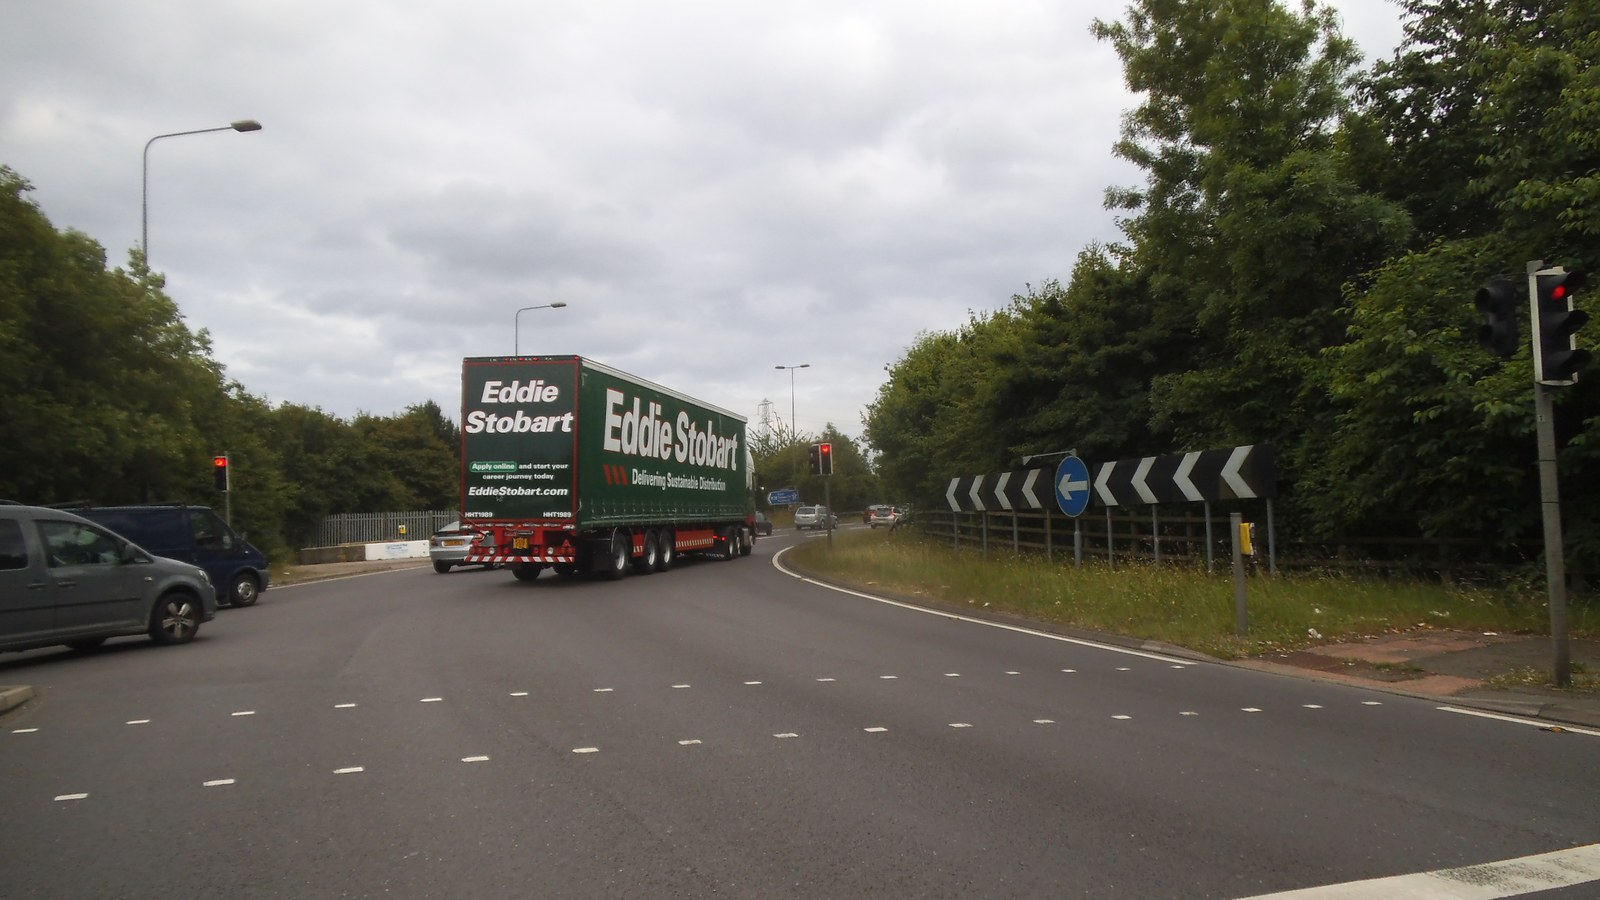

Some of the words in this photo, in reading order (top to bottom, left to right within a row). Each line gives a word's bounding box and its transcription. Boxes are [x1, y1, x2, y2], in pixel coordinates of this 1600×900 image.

[481, 380, 559, 403] Eddie
[465, 410, 574, 433] Stobart
[603, 387, 673, 461] Eddie
[674, 410, 738, 471] Stobart
[471, 463, 492, 471] Apply
[468, 486, 568, 496] EddieStobart.com
[632, 468, 667, 491] Delivering
[667, 472, 699, 489] Sustainable
[699, 476, 726, 491] Distribution
